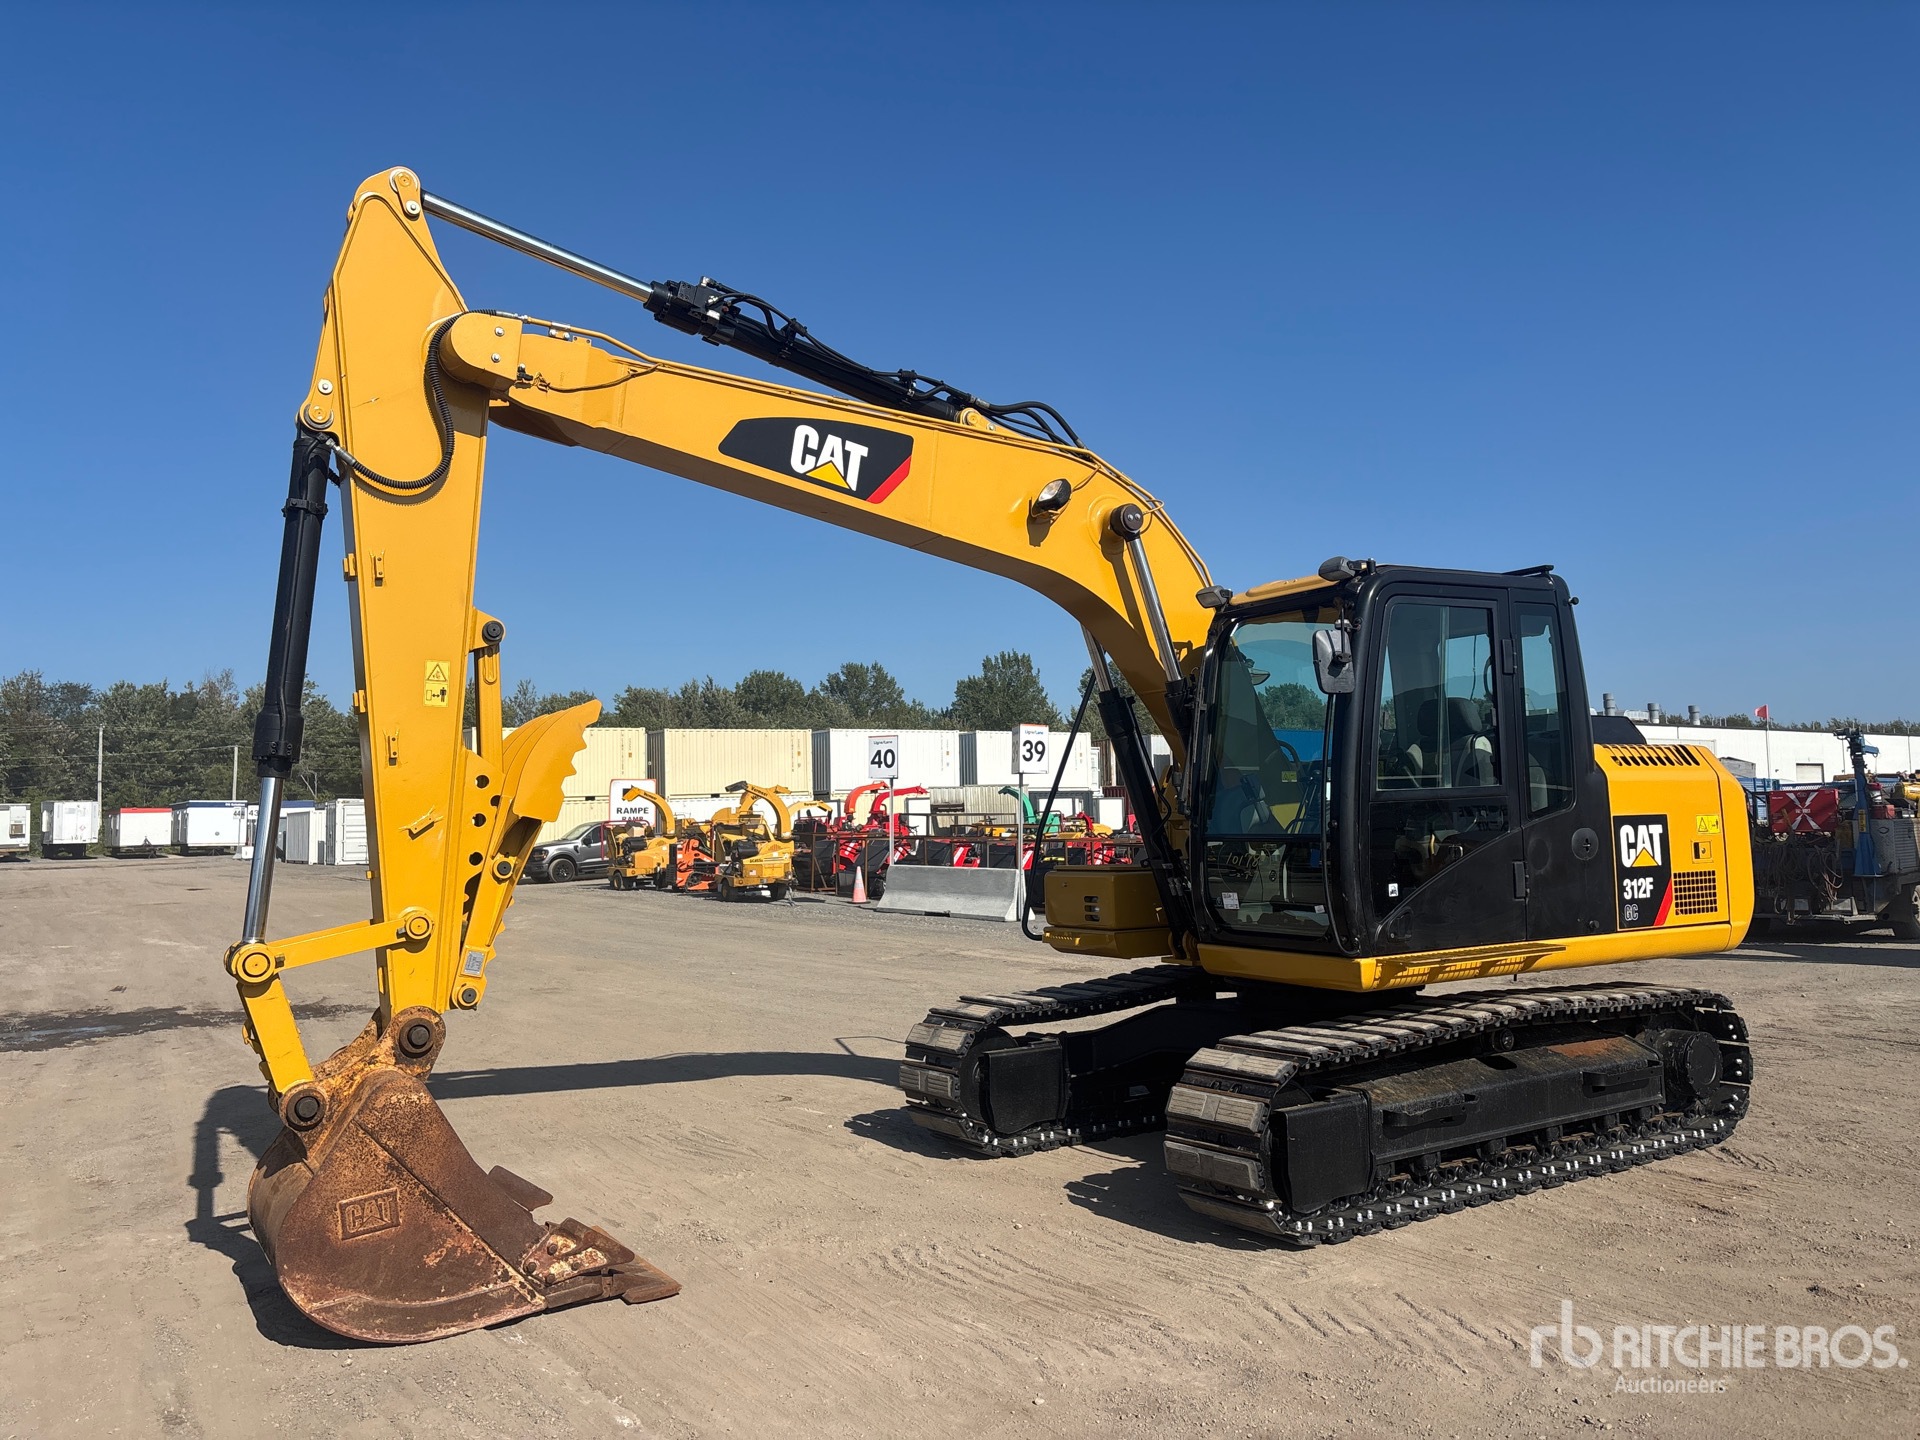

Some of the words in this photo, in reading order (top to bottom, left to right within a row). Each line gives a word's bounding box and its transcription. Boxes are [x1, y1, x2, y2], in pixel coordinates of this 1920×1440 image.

[790, 424, 869, 492] CAT
[870, 748, 896, 769] 40
[1022, 739, 1046, 762] 39
[248, 809, 259, 817] 43
[1619, 823, 1664, 868] CAT
[1622, 876, 1654, 900] 312F
[1624, 903, 1639, 921] GC
[345, 1197, 393, 1234] CAT
